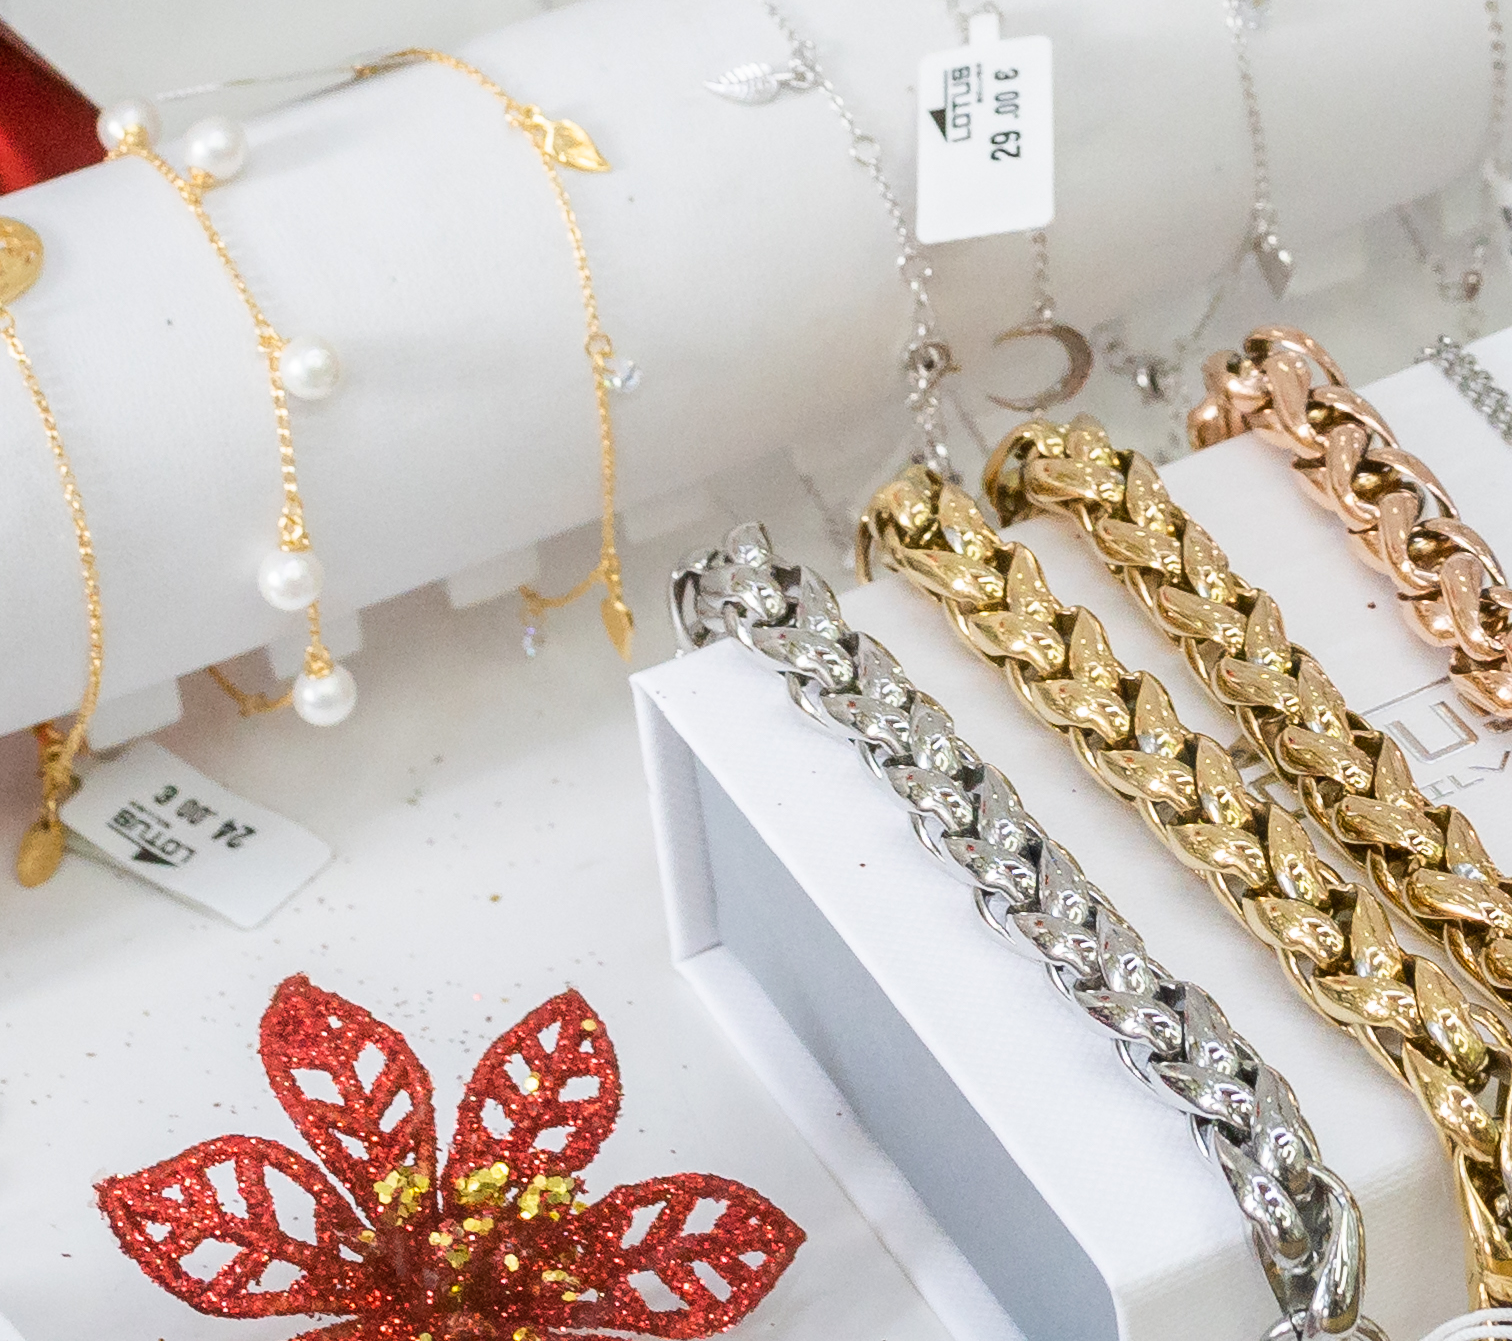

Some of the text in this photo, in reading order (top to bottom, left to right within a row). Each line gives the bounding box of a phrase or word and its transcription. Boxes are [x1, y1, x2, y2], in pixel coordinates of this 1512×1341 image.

[951, 66, 972, 144] LOTUS
[990, 68, 1021, 162] 29 .00 €
[210, 818, 257, 850] 24
